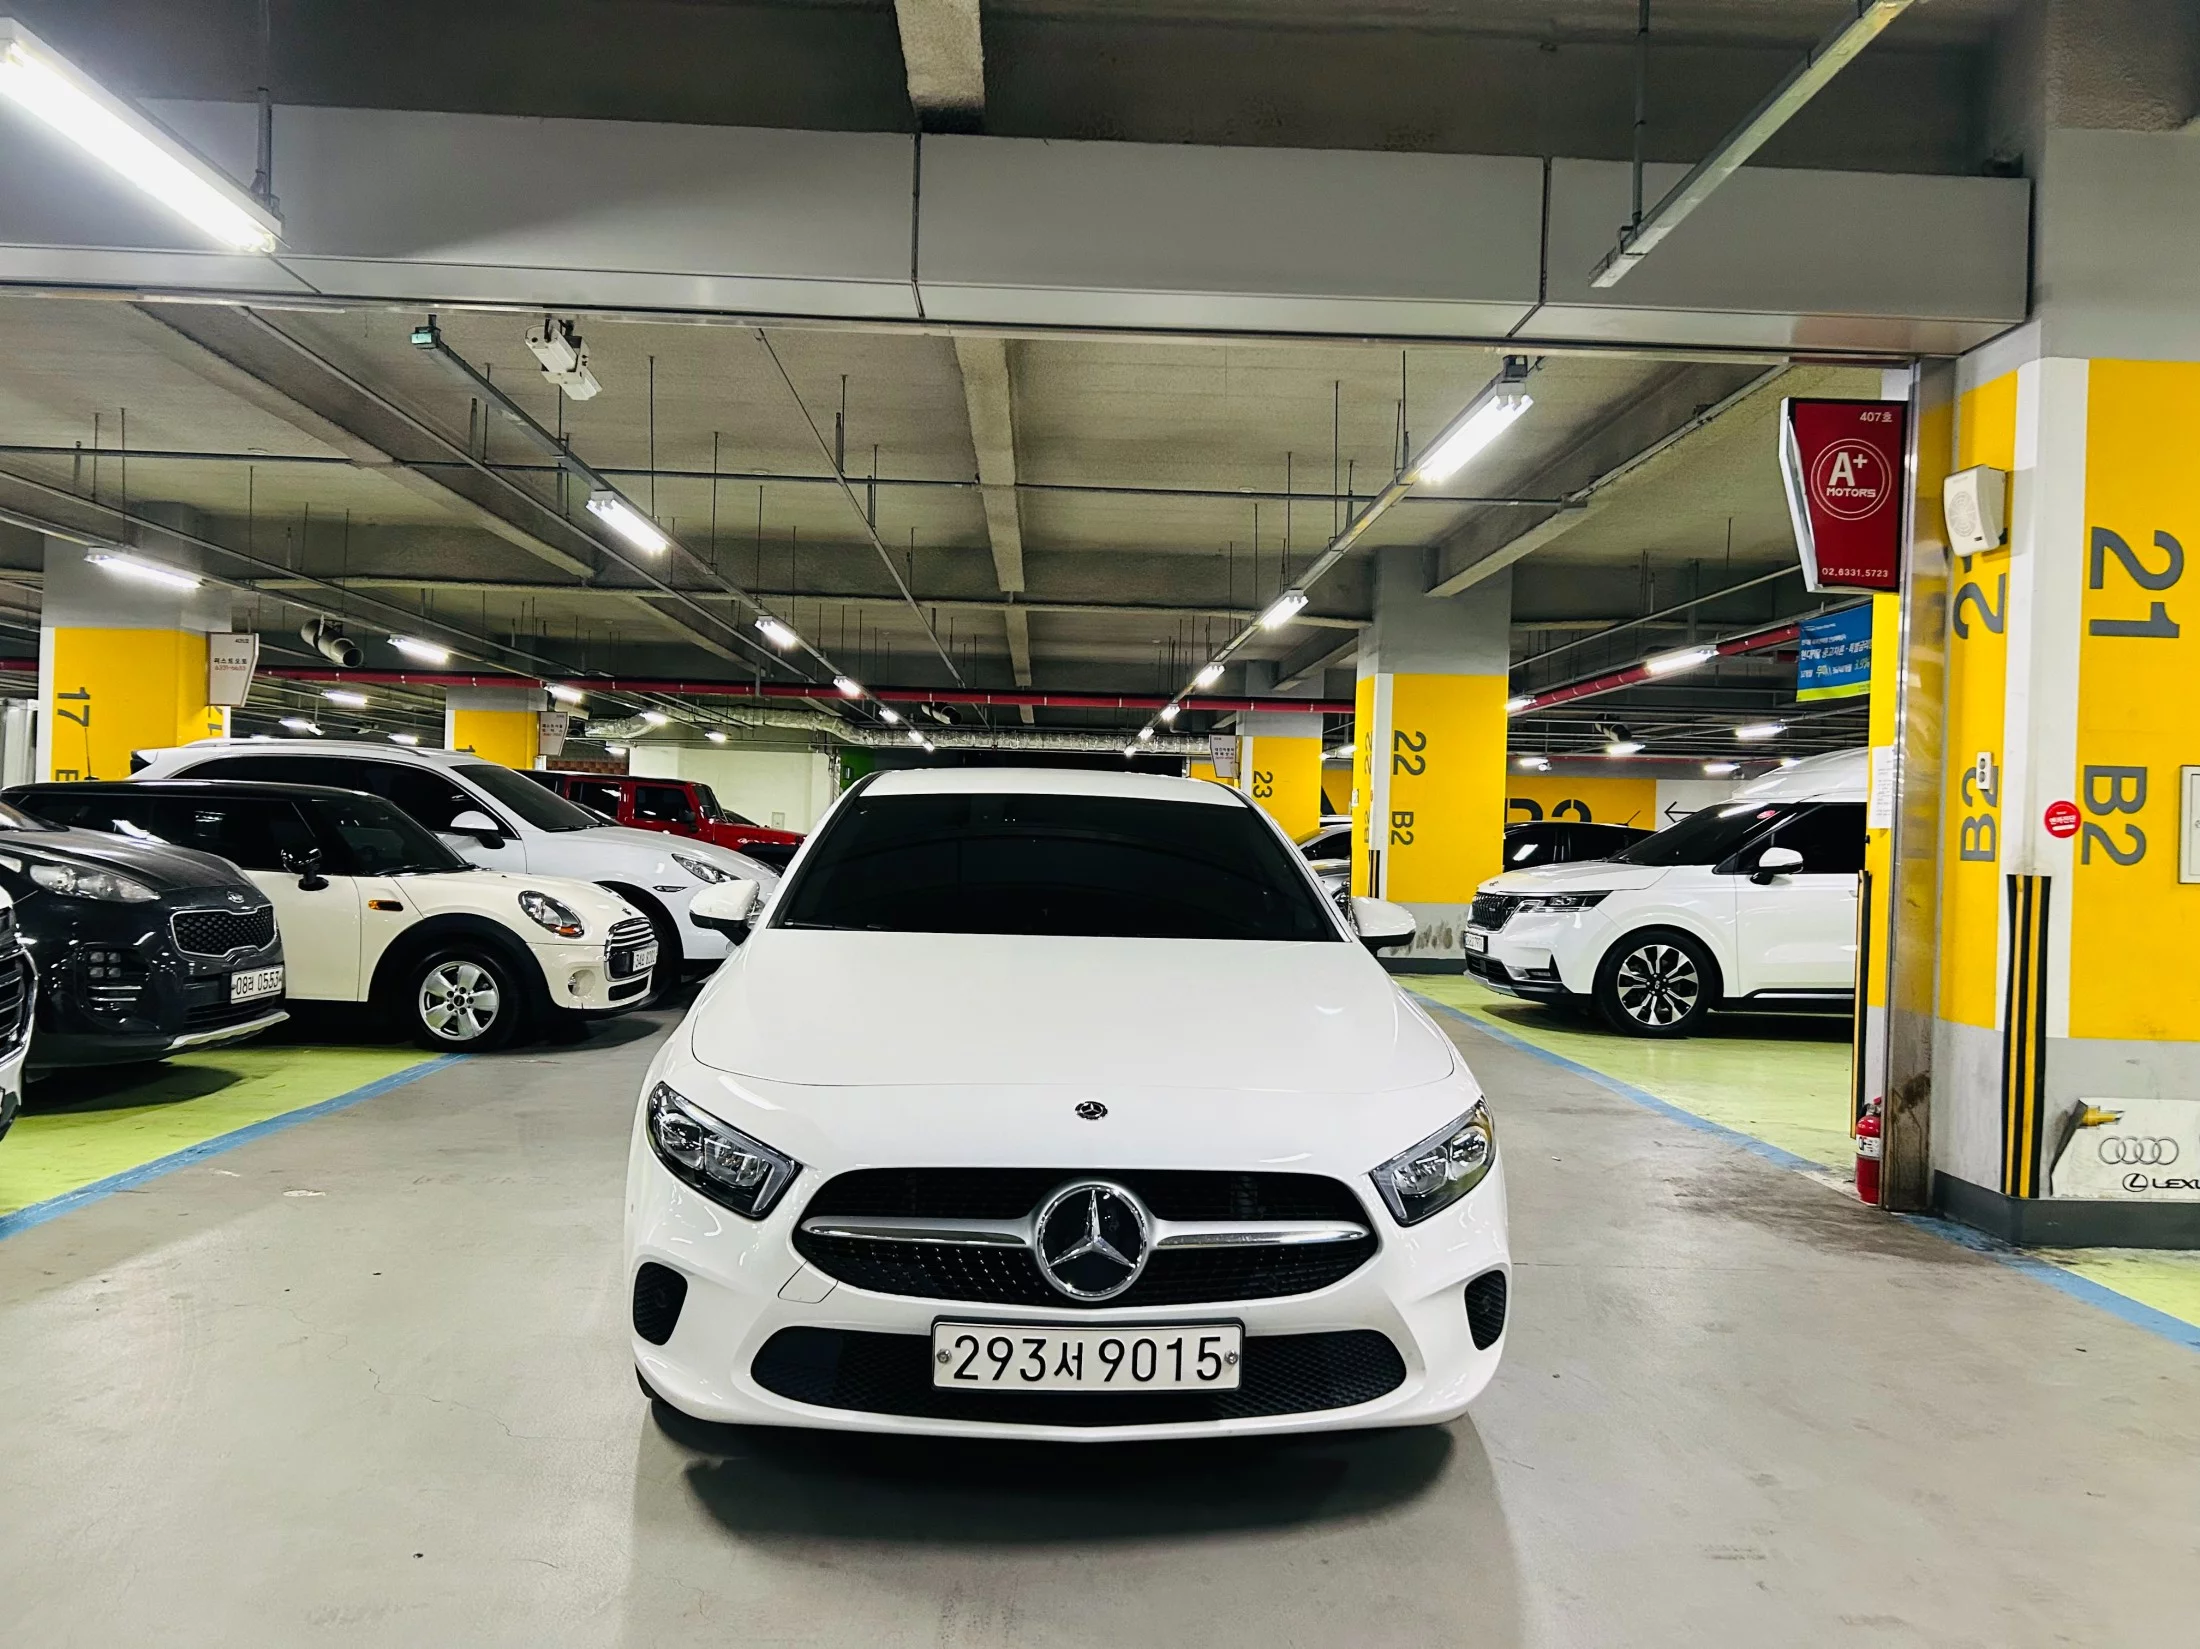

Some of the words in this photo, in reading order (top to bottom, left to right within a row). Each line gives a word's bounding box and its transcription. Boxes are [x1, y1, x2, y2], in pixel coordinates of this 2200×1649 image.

[1859, 412, 1893, 423] 407호
[1828, 451, 1868, 487] A+
[1826, 487, 1876, 498] MOTORS
[2089, 526, 2185, 638] 21
[57, 687, 91, 727] 17
[1392, 730, 1427, 776] 22
[1253, 770, 1273, 799] 23
[1391, 811, 1414, 845] B2
[1960, 765, 1999, 862] B2
[2081, 765, 2147, 865] B2
[953, 1334, 1084, 1383] 293서
[1098, 1336, 1223, 1382] 9015
